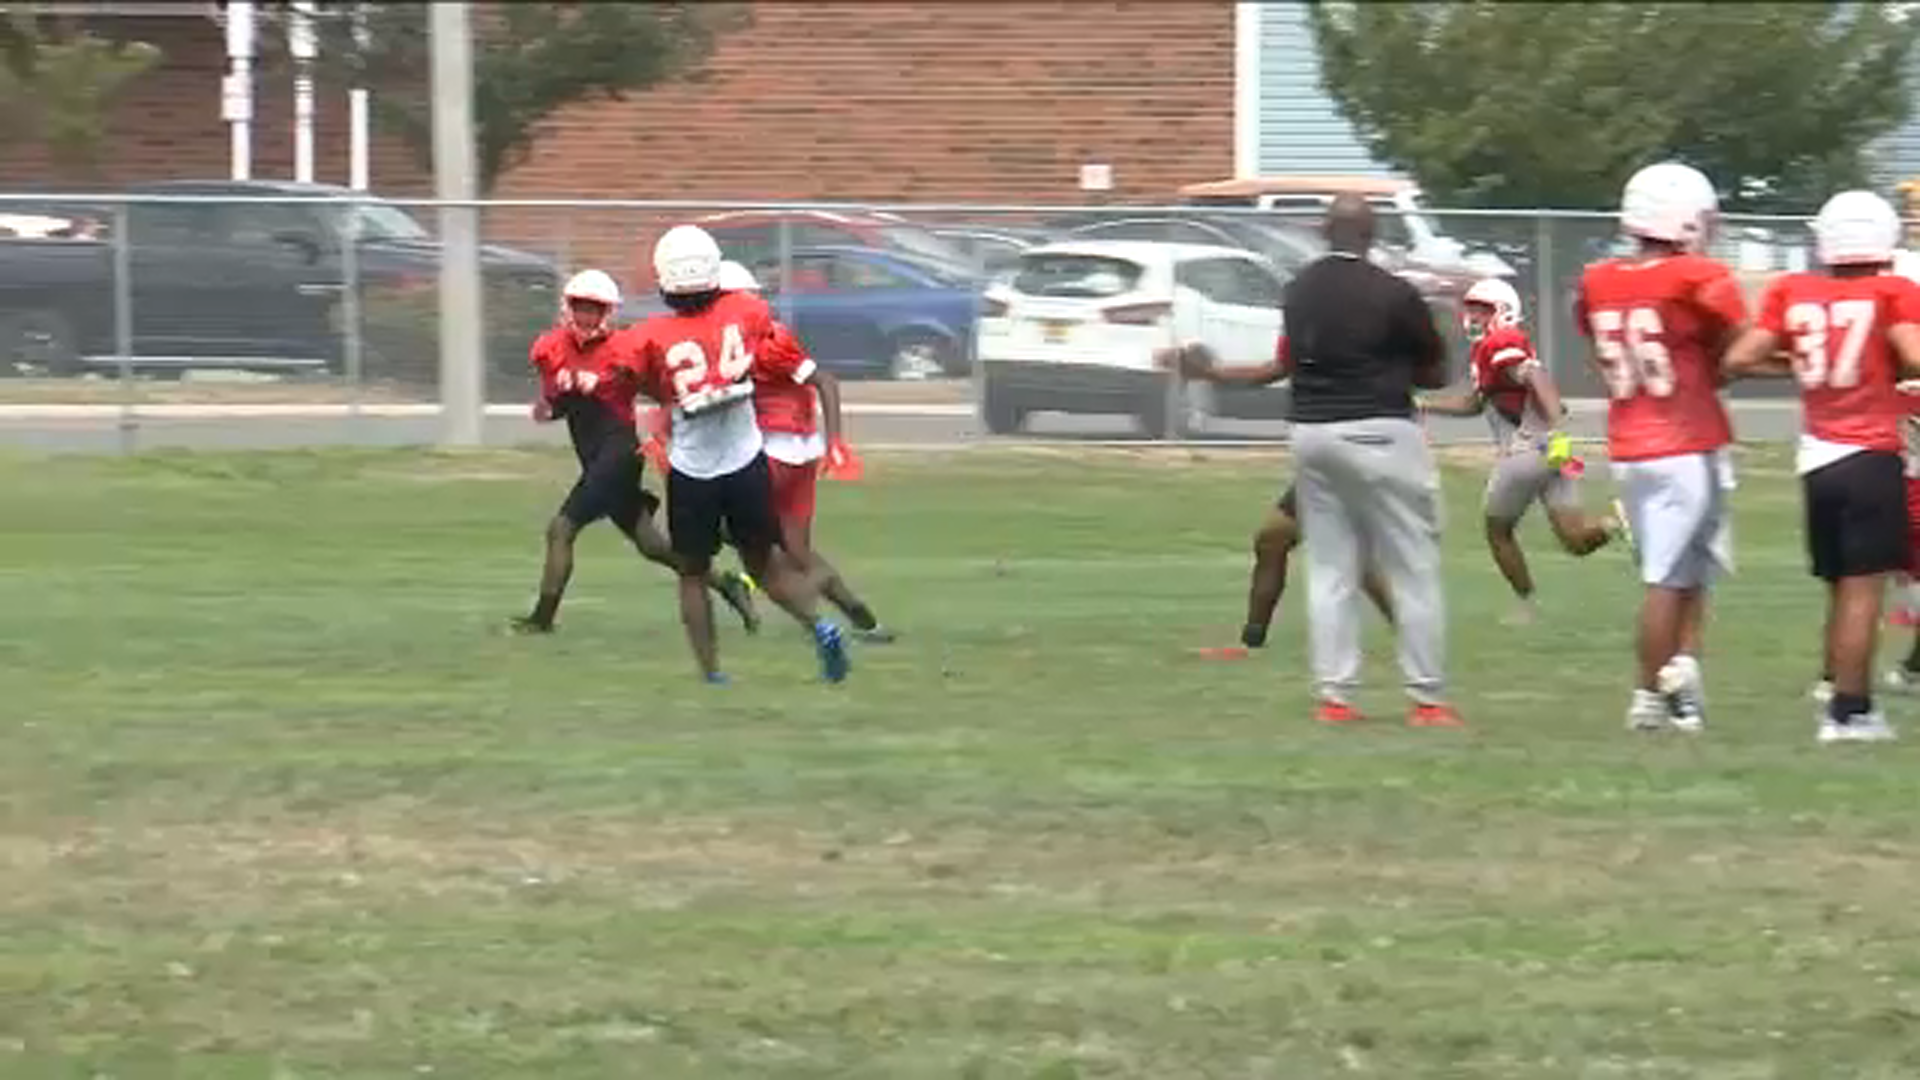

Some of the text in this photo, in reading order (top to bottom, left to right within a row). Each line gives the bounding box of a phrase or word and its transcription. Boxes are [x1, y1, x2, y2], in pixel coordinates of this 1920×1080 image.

[666, 323, 754, 400] 24
[1590, 308, 1675, 399] 56
[1785, 300, 1875, 388] 37
